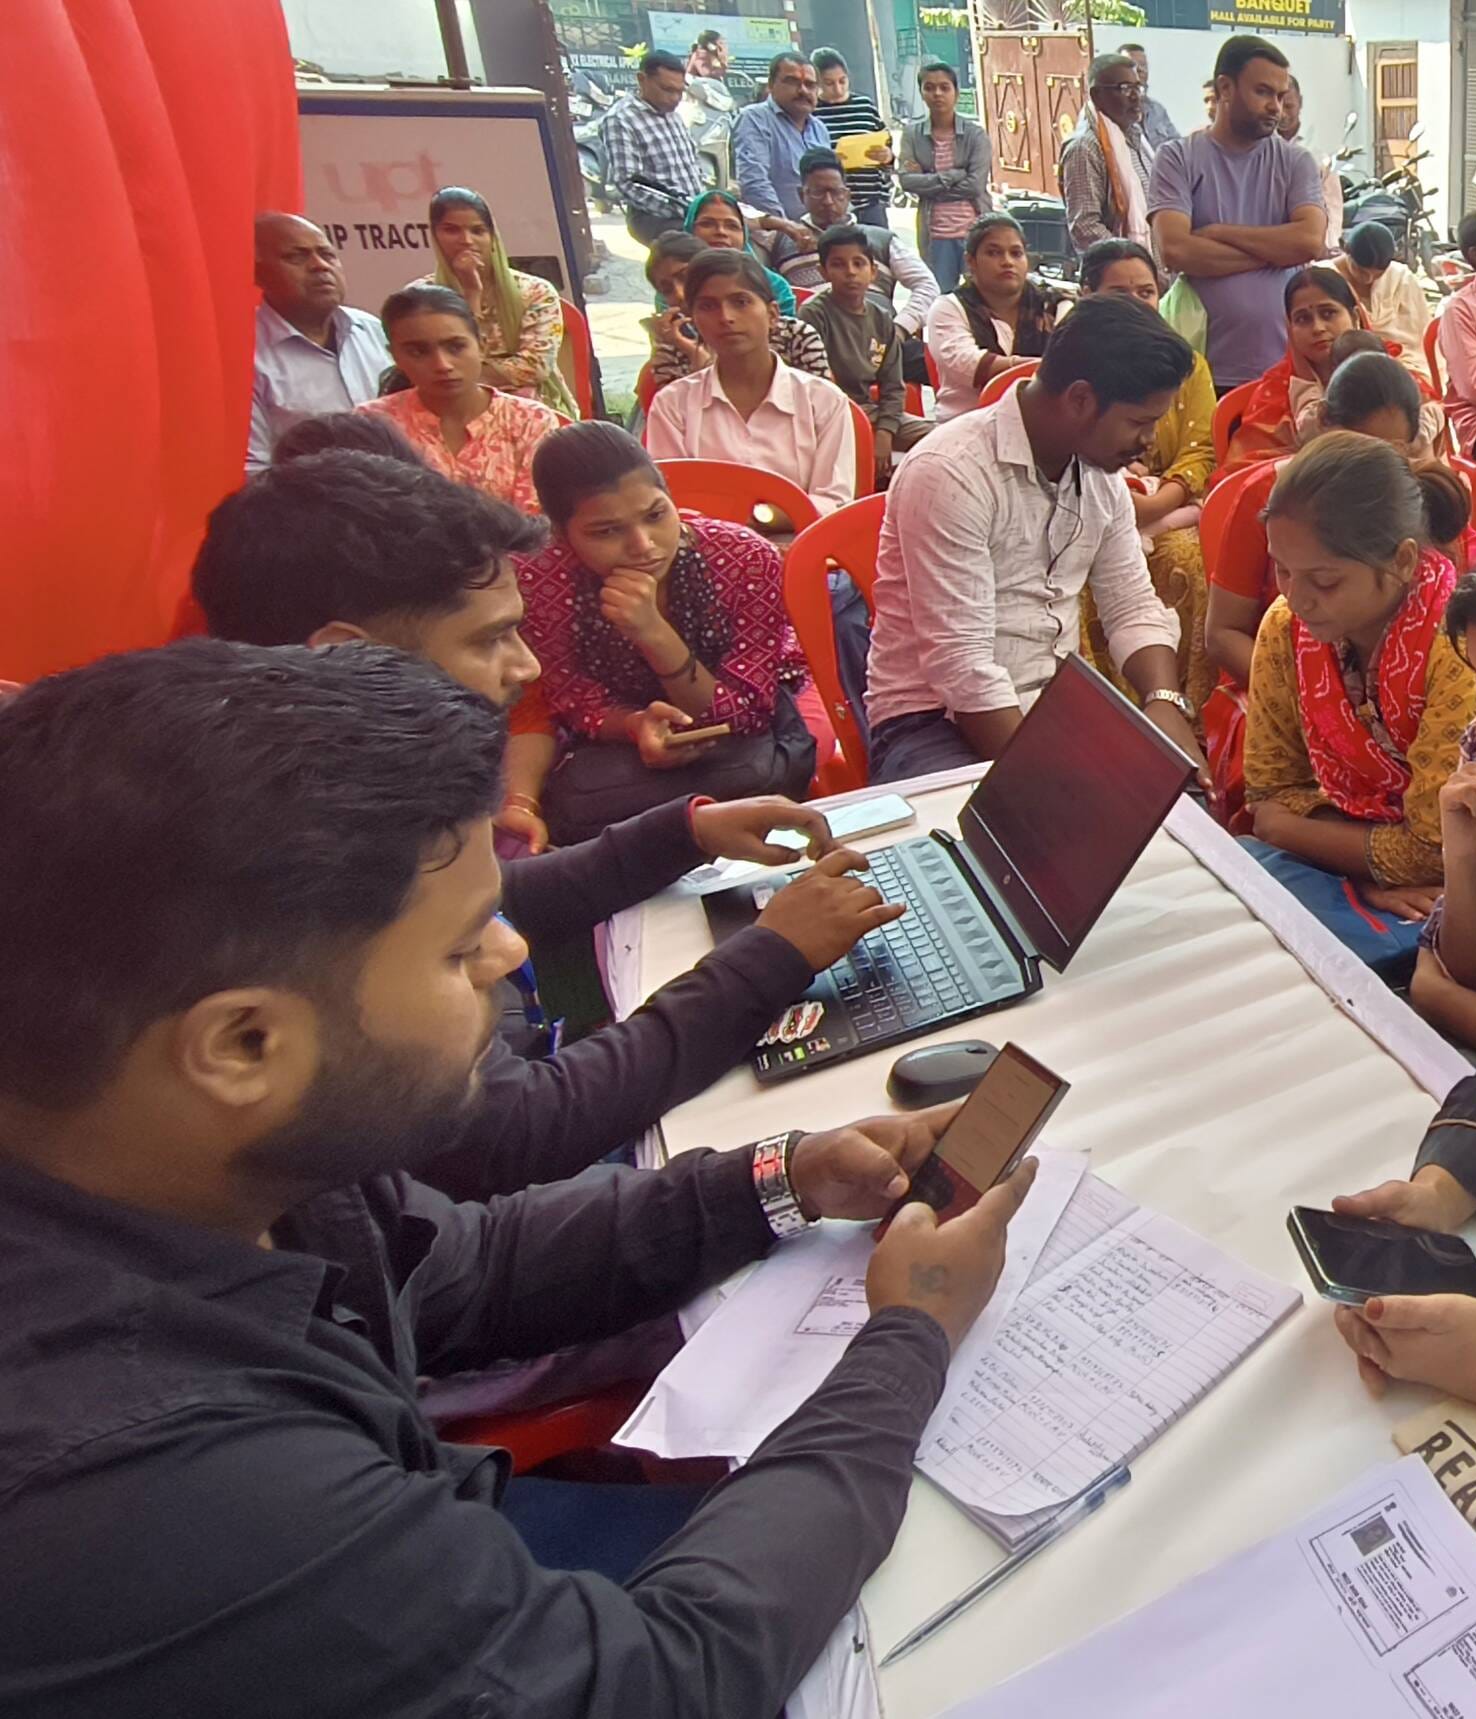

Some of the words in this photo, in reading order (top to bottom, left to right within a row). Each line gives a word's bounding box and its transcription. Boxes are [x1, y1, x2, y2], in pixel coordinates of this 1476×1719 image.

[1236, 0, 1312, 14] BANQUET
[1210, 10, 1235, 22] HALL
[1237, 12, 1286, 26] AVAILABLE
[1287, 16, 1306, 28] FOR
[1307, 18, 1335, 29] PARTY
